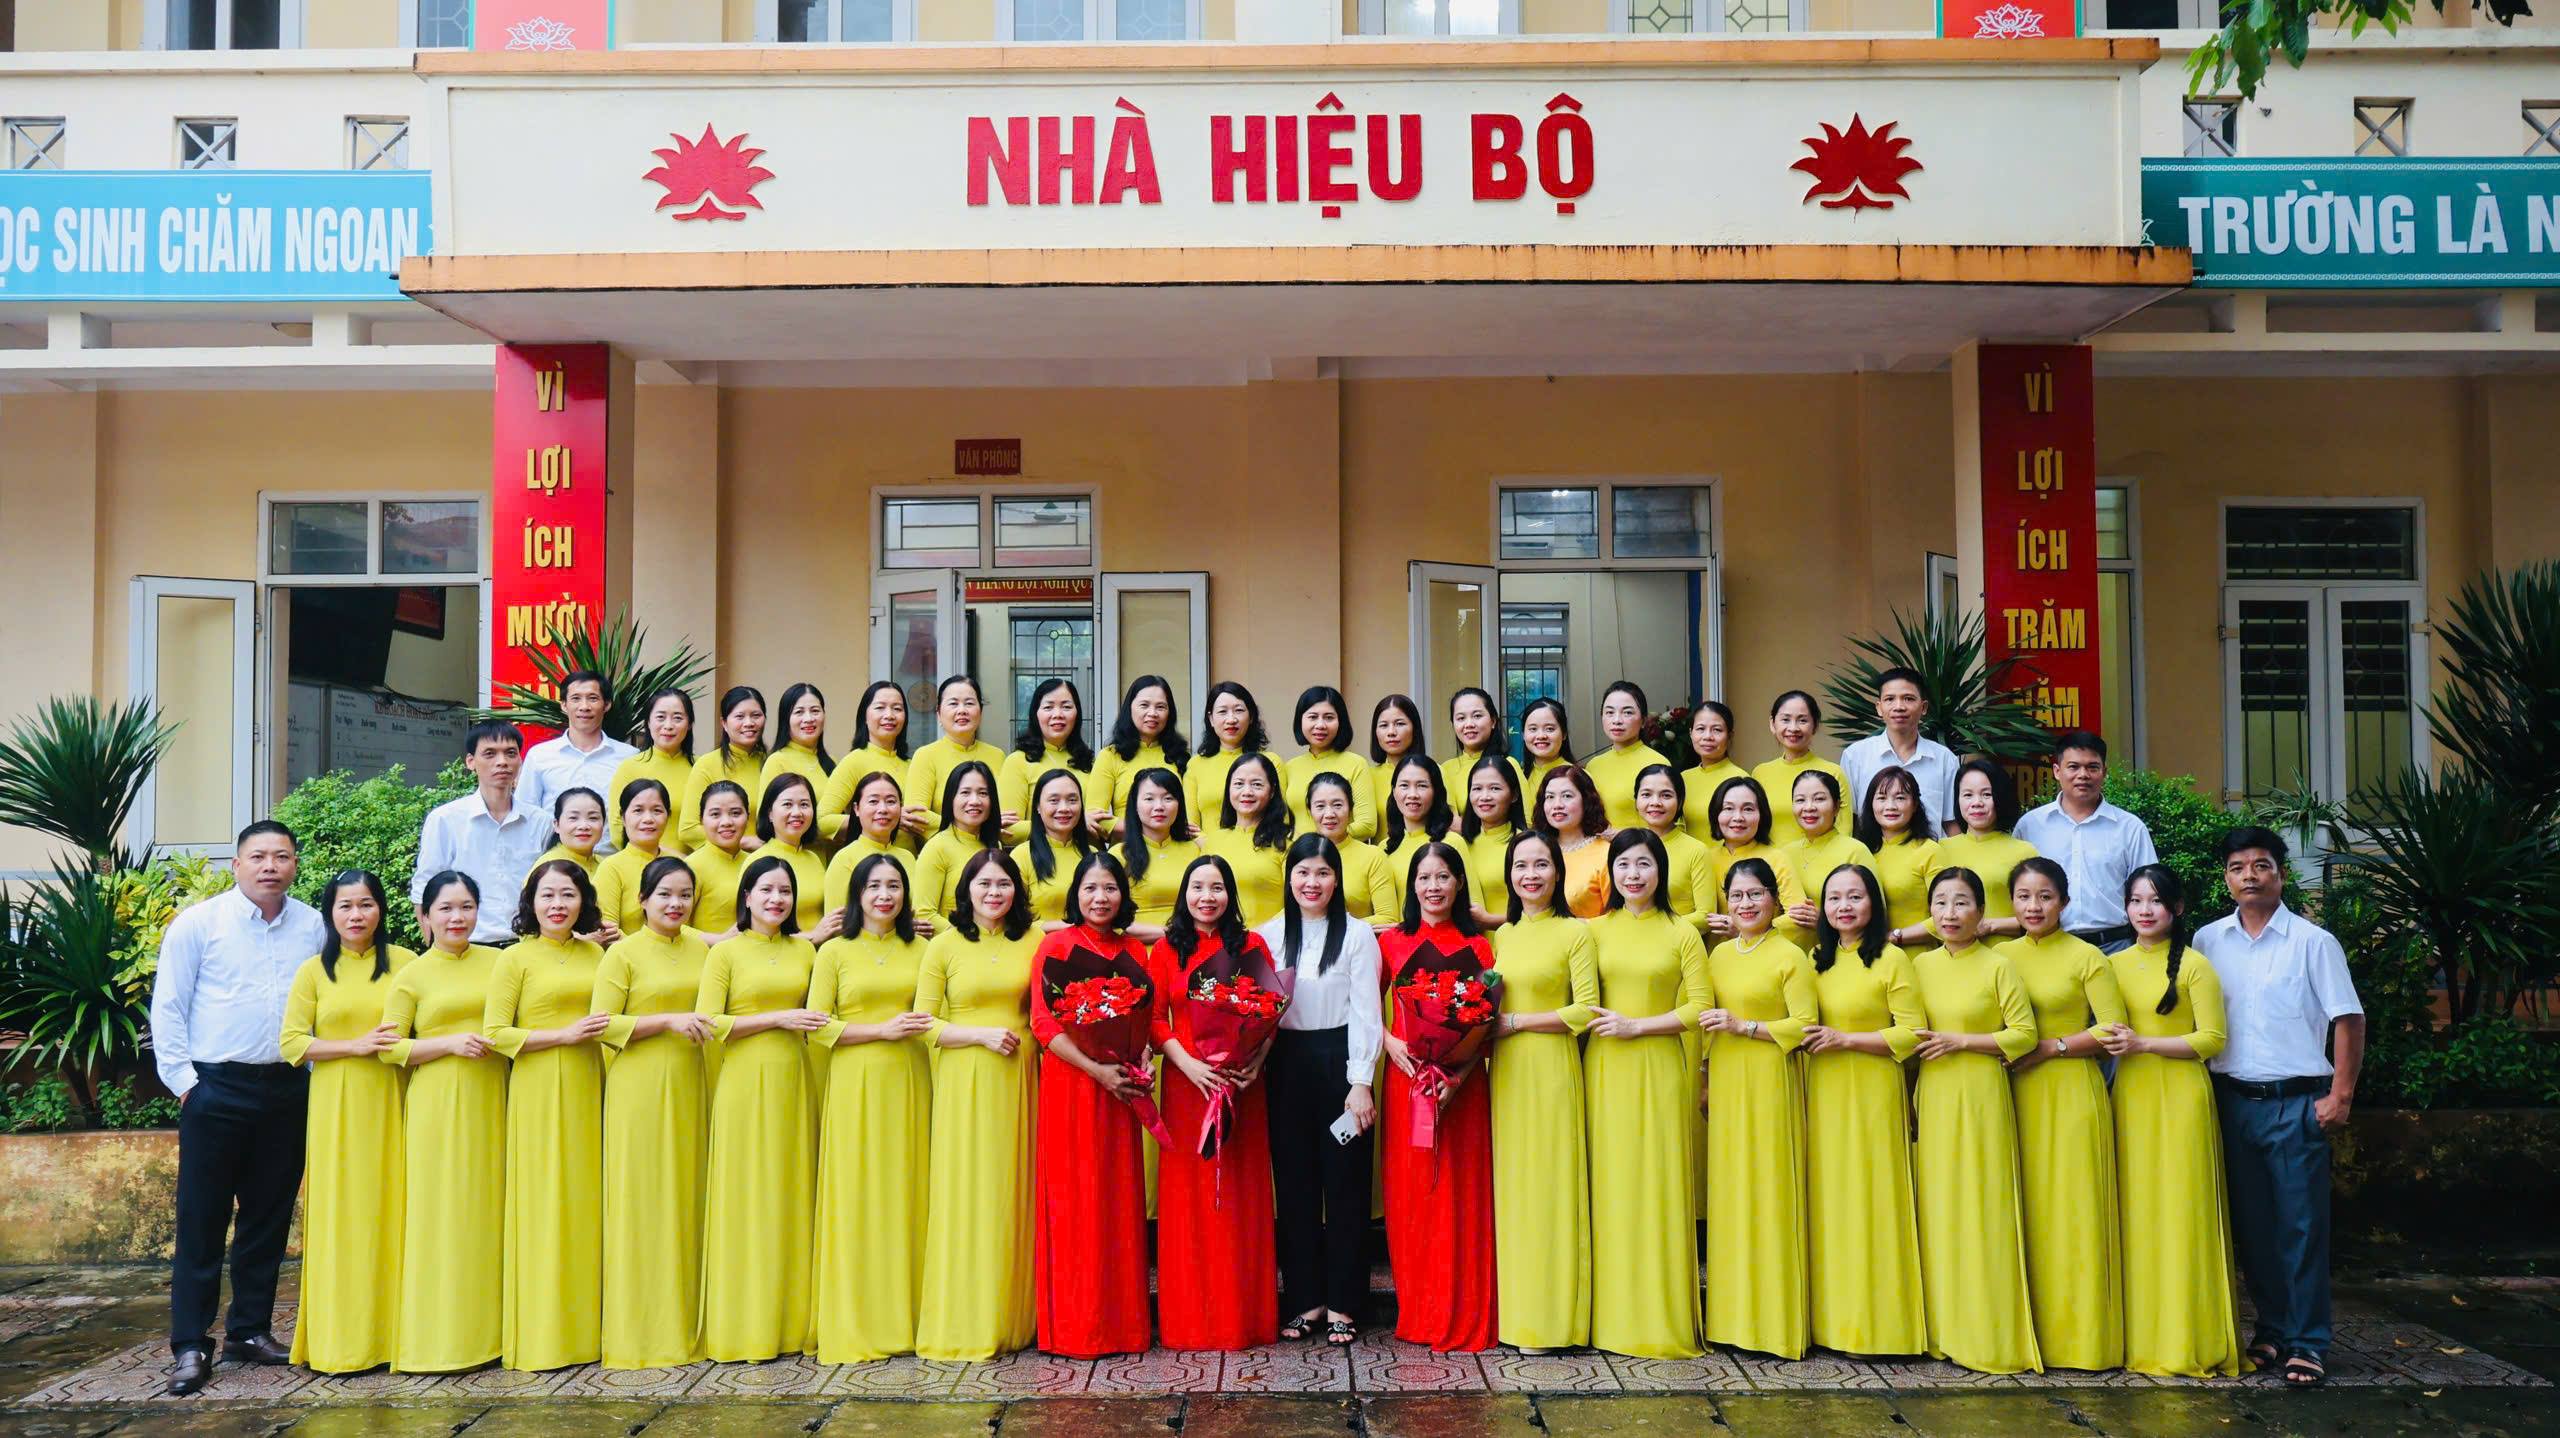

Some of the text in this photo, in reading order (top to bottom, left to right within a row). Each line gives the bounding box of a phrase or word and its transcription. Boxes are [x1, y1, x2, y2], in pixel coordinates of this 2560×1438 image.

[966, 90, 1596, 219] NHÀ HIỆU BỘ
[53, 206, 146, 273] SINH
[159, 192, 272, 274] CHĂM
[285, 206, 418, 274] NGOAN
[2178, 180, 2415, 255] TRƯỜNG
[2436, 182, 2509, 255] LÀ
[535, 361, 566, 412] VÌ
[2023, 362, 2055, 414] VÌ
[526, 444, 571, 497] LỢI
[2017, 449, 2064, 500] LỢI
[524, 517, 573, 568] ÍCH
[2017, 519, 2068, 571] ÍCH
[507, 592, 587, 647] MƯỜI
[2003, 598, 2086, 650] TRĂM
